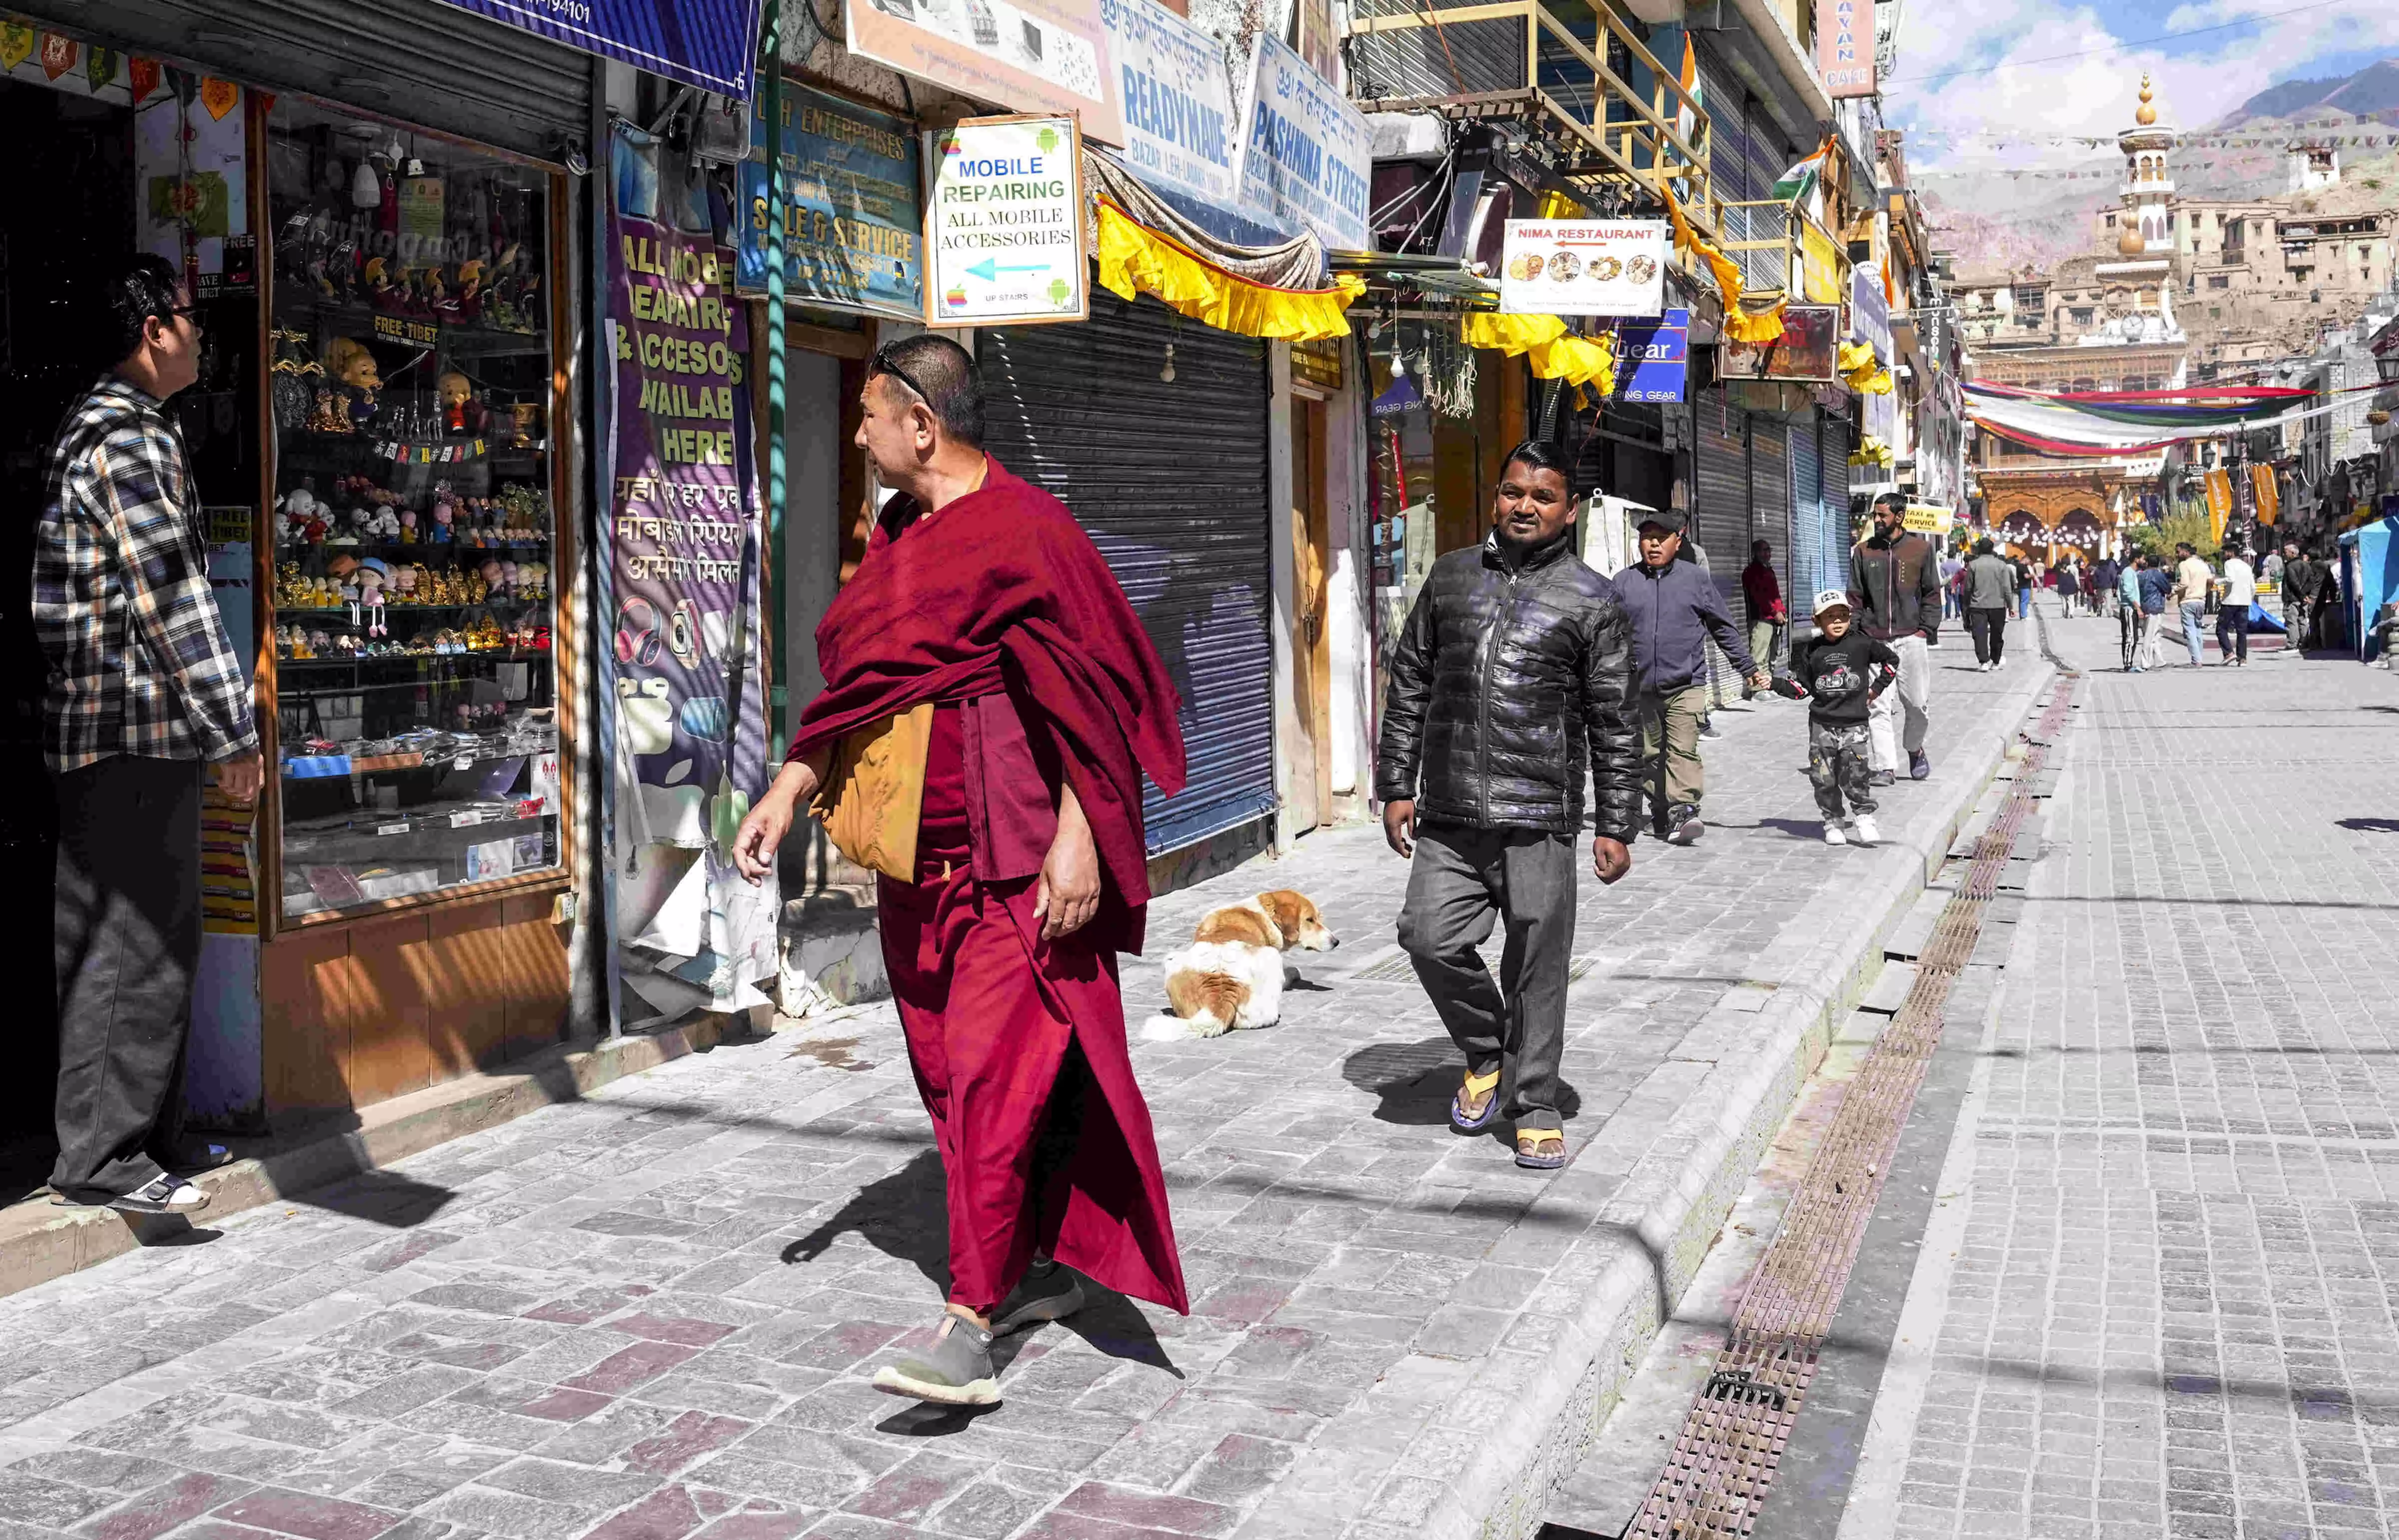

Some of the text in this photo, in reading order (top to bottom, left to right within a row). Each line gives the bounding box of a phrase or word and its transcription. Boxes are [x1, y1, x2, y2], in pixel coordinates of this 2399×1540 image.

[1827, 68, 1868, 86] CAFE
[1123, 63, 1228, 168] READYMADE
[801, 105, 905, 161] ENTERPRISES
[959, 157, 1044, 177] MOBILE
[1253, 100, 1321, 191] PASHMINA
[1324, 154, 1367, 221] STREET
[943, 180, 1064, 203] REPAIRING
[947, 207, 1063, 228] ALL MOBILE
[753, 198, 808, 238] SLE
[833, 216, 913, 261] SERVICE
[941, 229, 1071, 250] ACCESSORIES
[1518, 229, 1654, 239] NIMA RESTAURANT
[223, 235, 256, 249] FREE
[623, 234, 665, 277] ALL
[375, 315, 402, 336] FREE
[406, 322, 438, 343] TIBET
[1647, 391, 1676, 400] GEAR
[663, 427, 732, 465] HERE
[214, 511, 249, 522] FREE
[1905, 518, 1937, 527] SERVICE
[212, 526, 247, 539] TIBET
